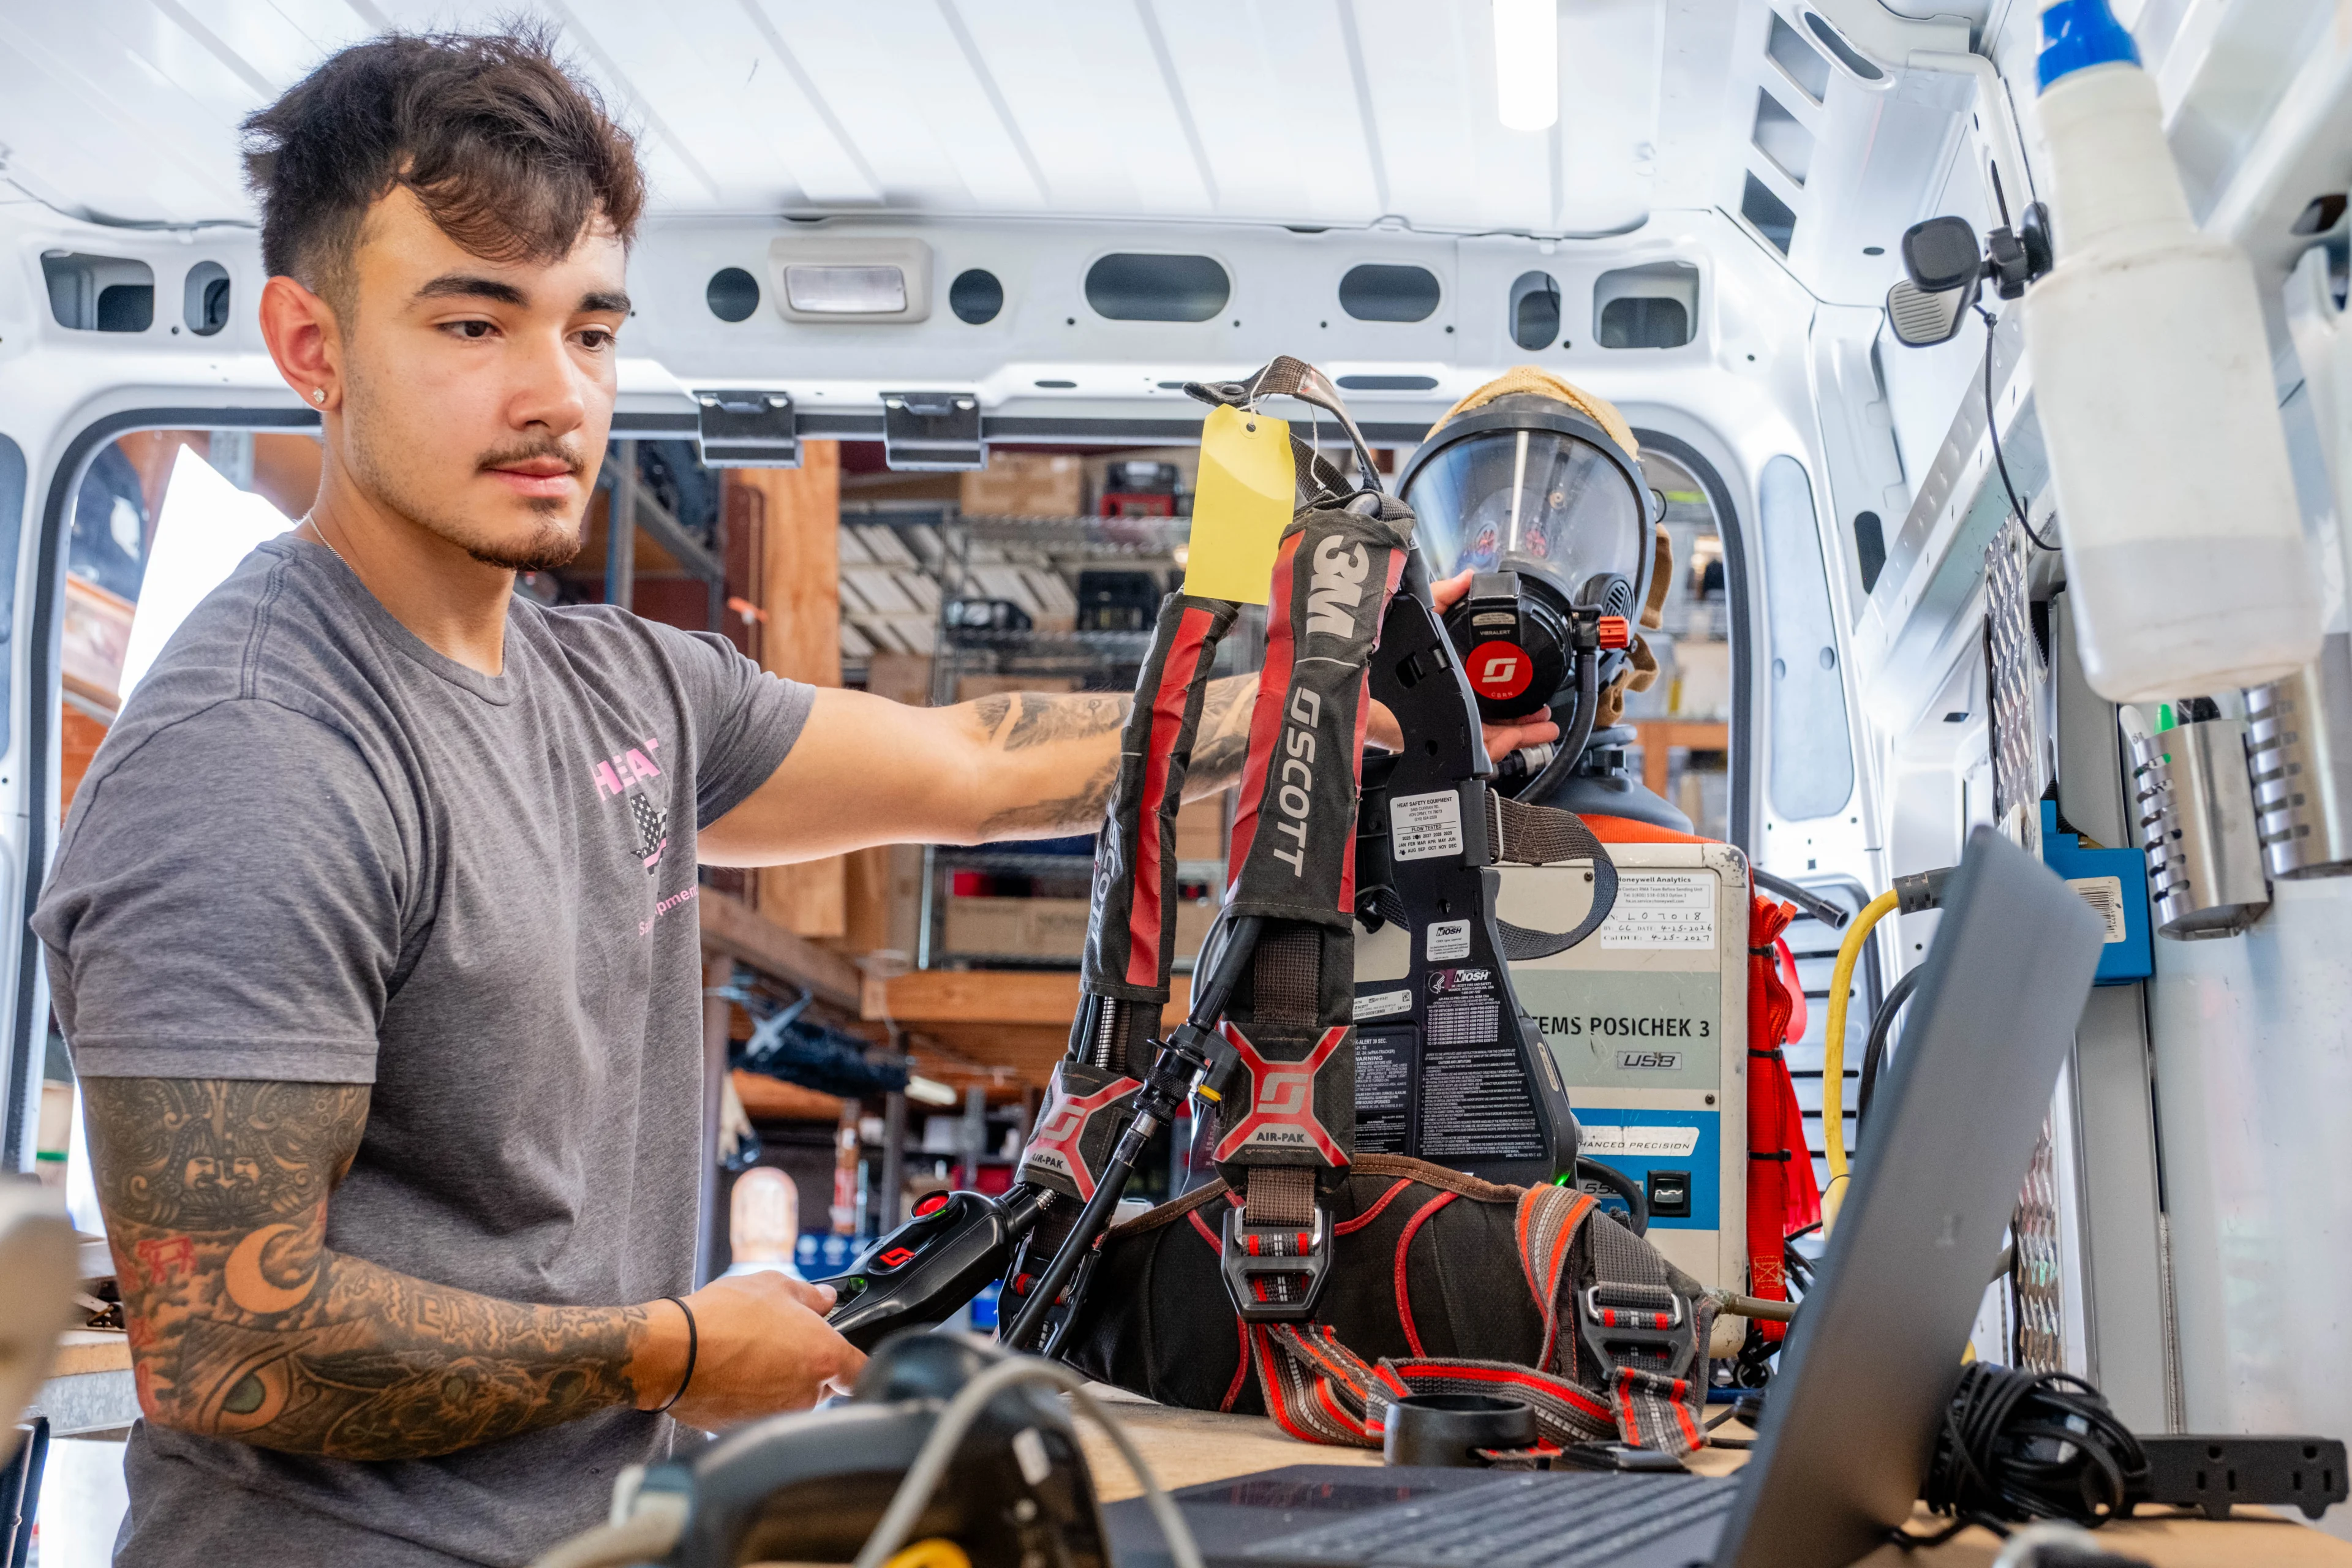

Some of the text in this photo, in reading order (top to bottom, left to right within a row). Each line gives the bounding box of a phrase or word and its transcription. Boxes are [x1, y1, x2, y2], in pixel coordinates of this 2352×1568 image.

[1306, 535, 1369, 639] 3M
[590, 737, 660, 801] HEAT
[1273, 730, 1316, 878] SCOTT
[1091, 821, 1118, 951] SCOTT
[1436, 927, 1462, 937] NIOSH
[1454, 970, 1488, 982] NIOSH
[1590, 1017, 1692, 1037] POSICHEK
[1700, 1020, 1709, 1037] 3
[1624, 1054, 1676, 1068] USB
[1256, 1132, 1305, 1142] AIR-PAK
[1031, 1153, 1063, 1169] AIR-PAK
